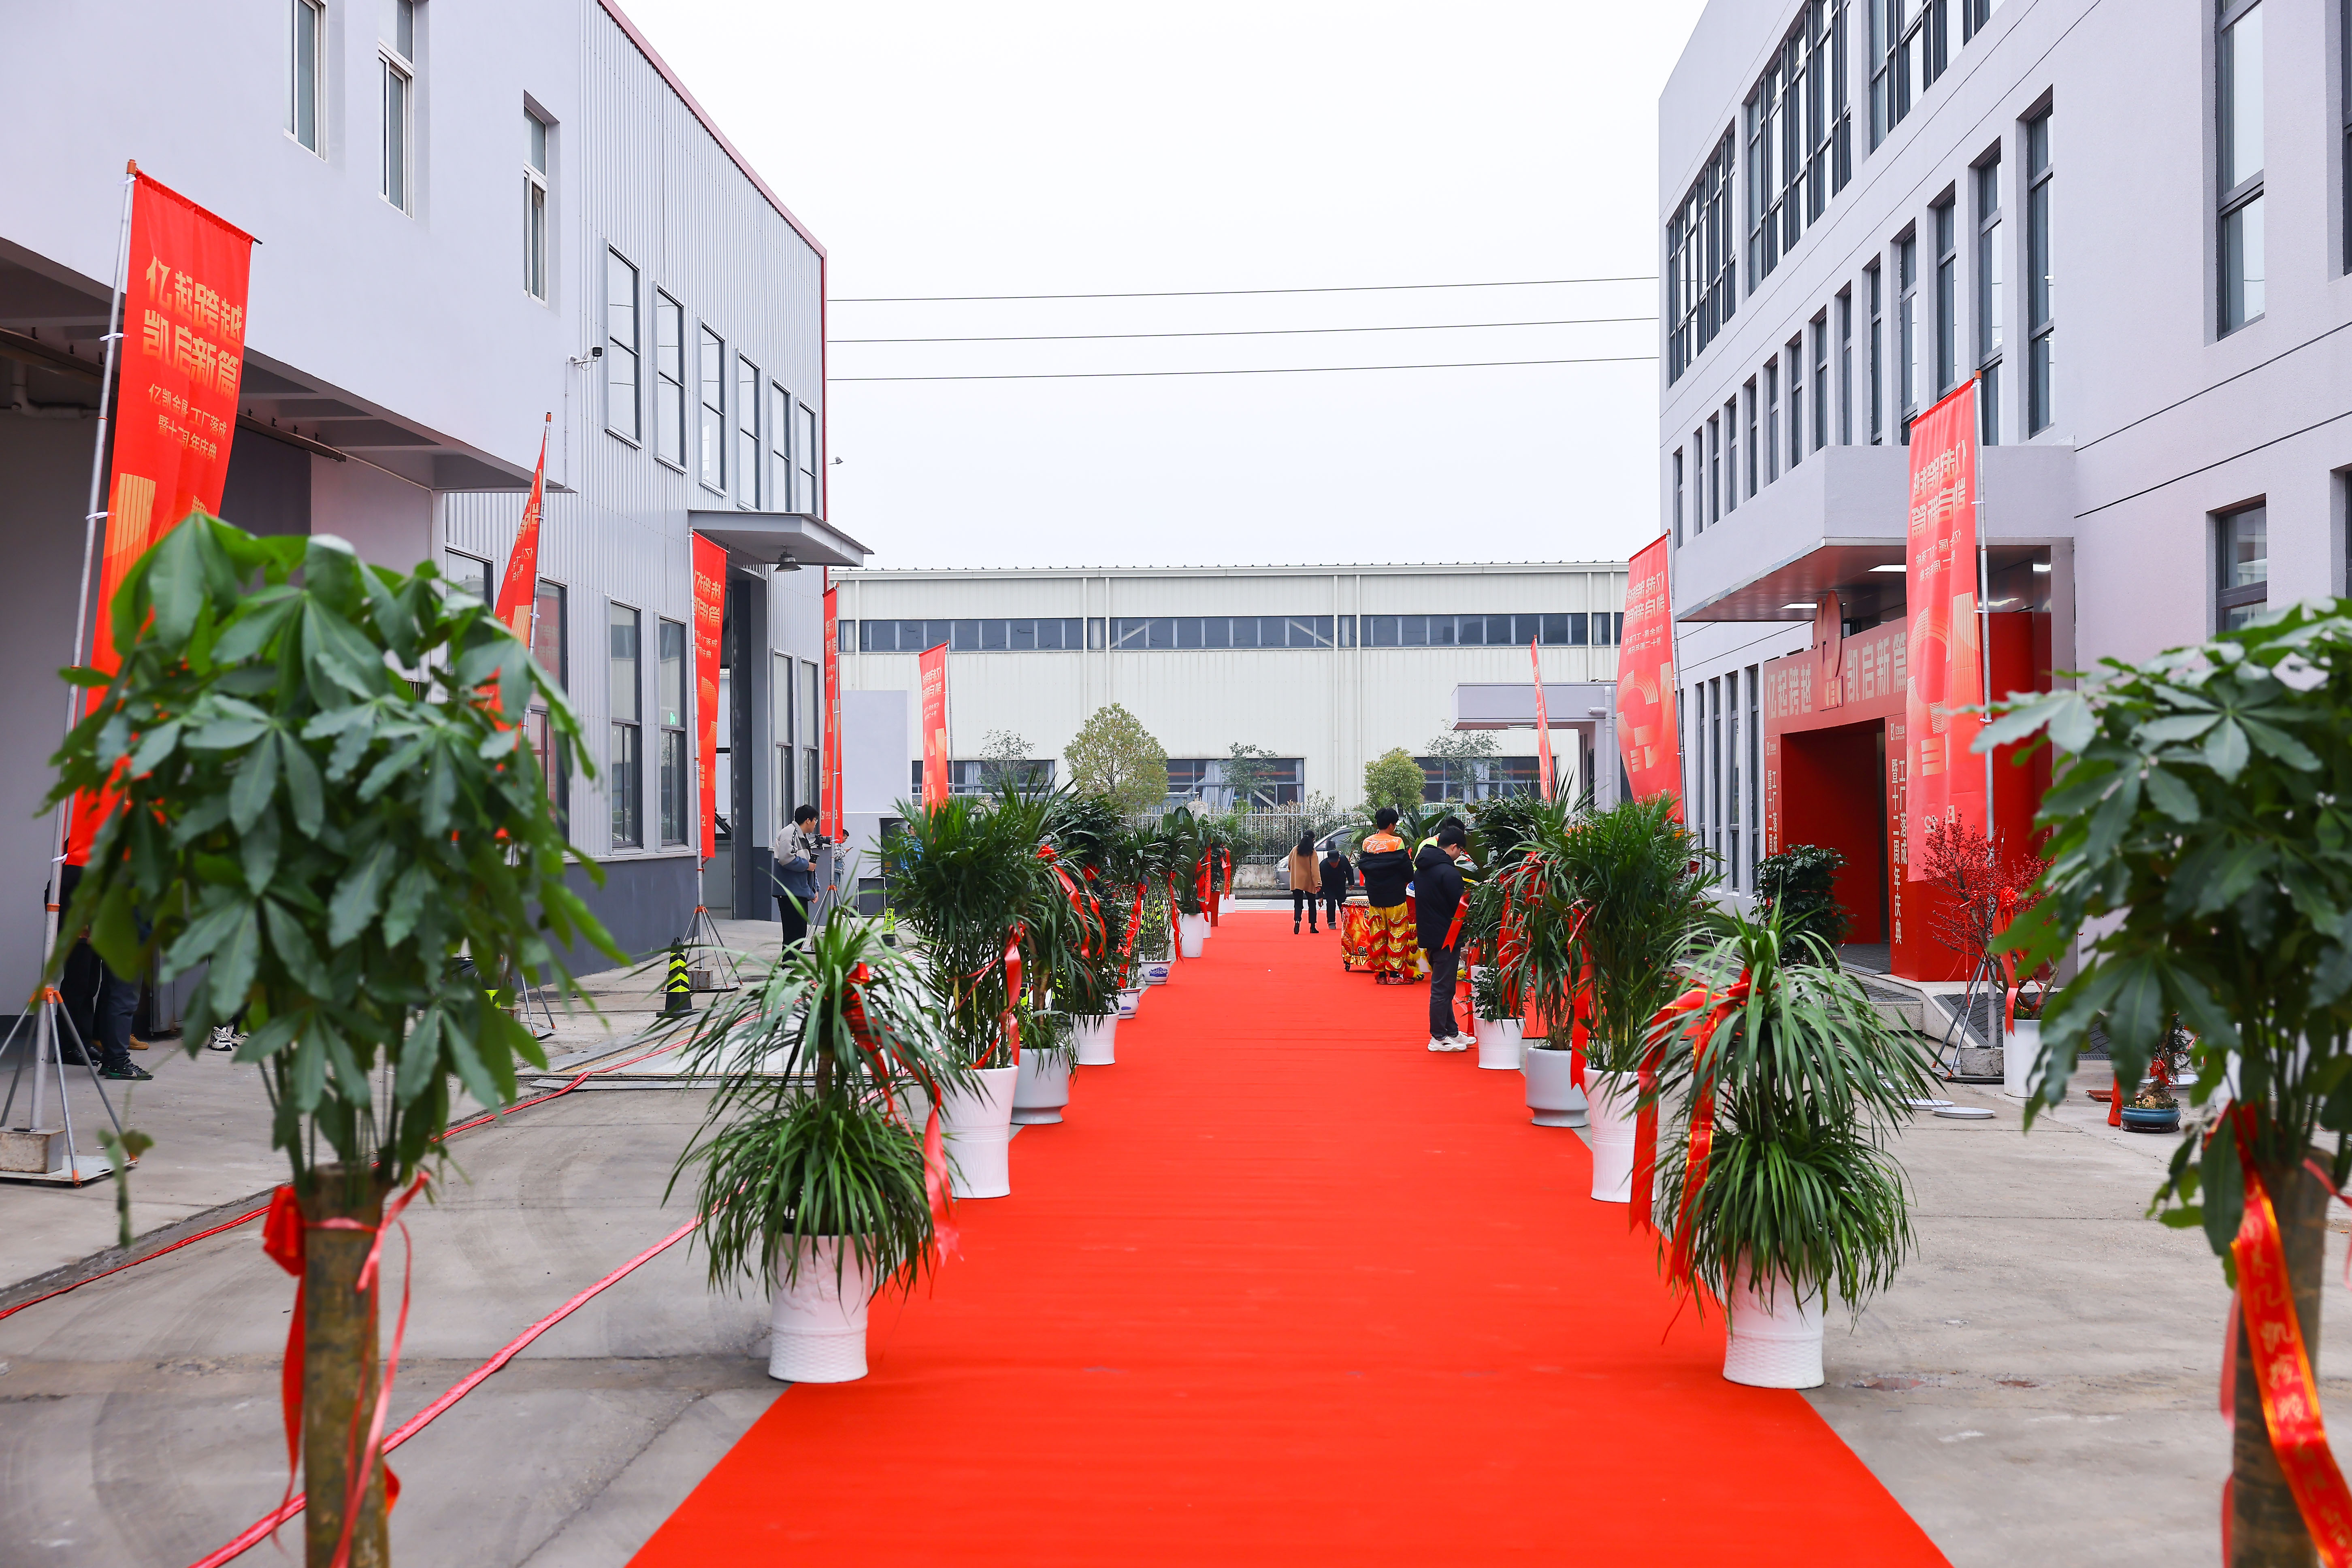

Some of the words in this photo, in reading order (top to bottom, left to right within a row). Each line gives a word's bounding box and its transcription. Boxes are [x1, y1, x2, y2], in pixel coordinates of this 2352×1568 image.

[146, 256, 242, 351] 亿起跨越
[143, 309, 239, 402] 凯启新篇
[1768, 663, 1811, 720] 亿起跨越
[1847, 632, 1907, 703] 凯启新篇
[1892, 758, 1902, 945] 暨十二周年庆典
[1899, 760, 1907, 865] 工厂落成
